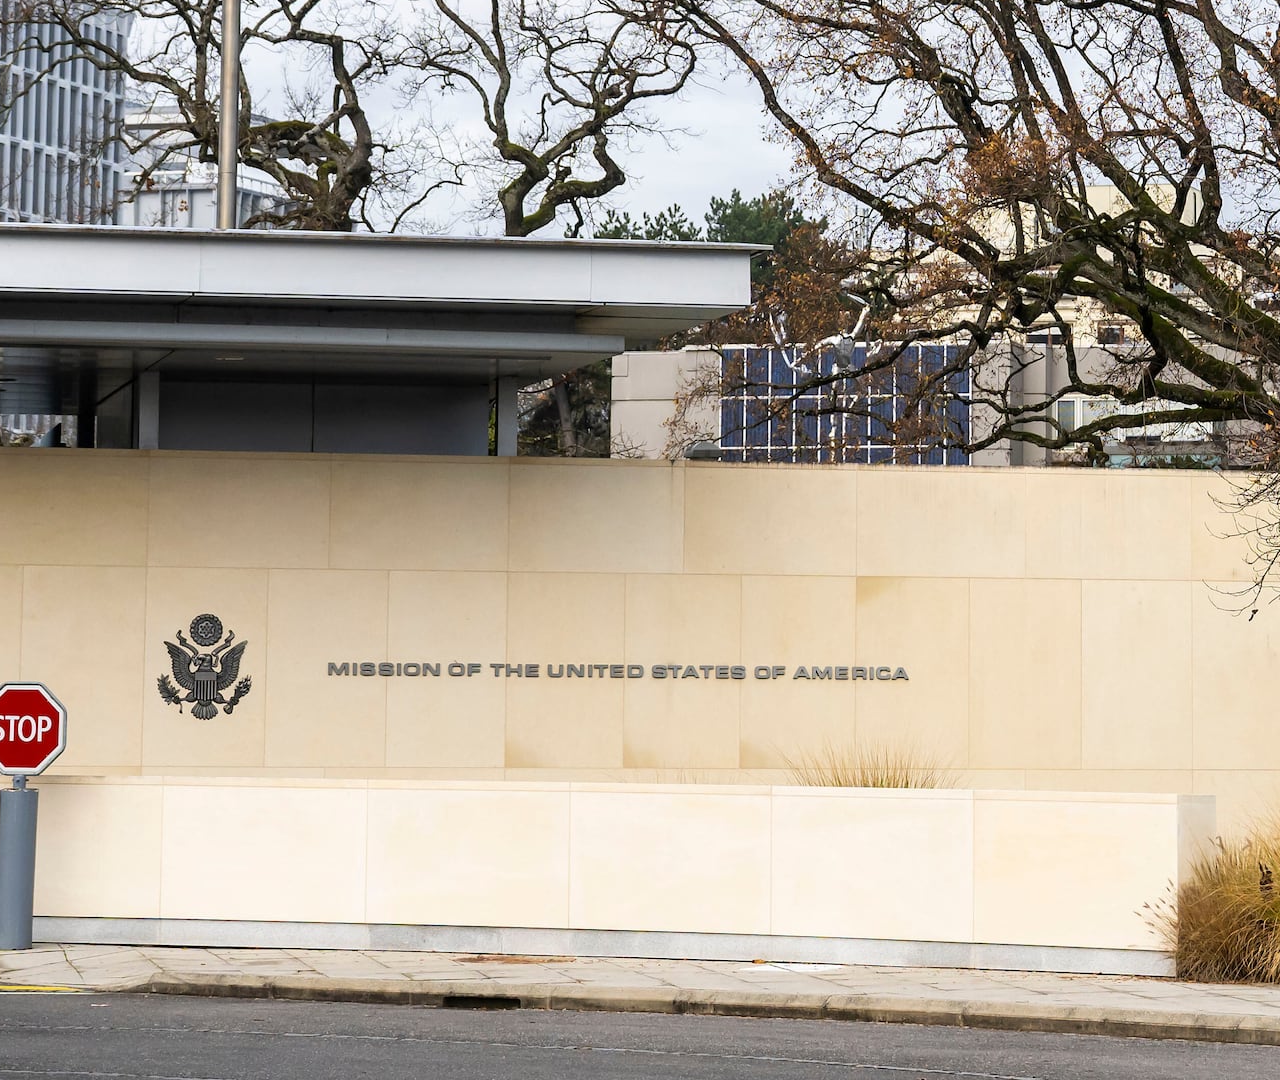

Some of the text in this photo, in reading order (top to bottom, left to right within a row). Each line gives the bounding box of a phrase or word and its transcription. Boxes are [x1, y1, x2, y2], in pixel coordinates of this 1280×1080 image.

[327, 662, 909, 681] MISSION OF THE UNITED STATES OF AMERICA
